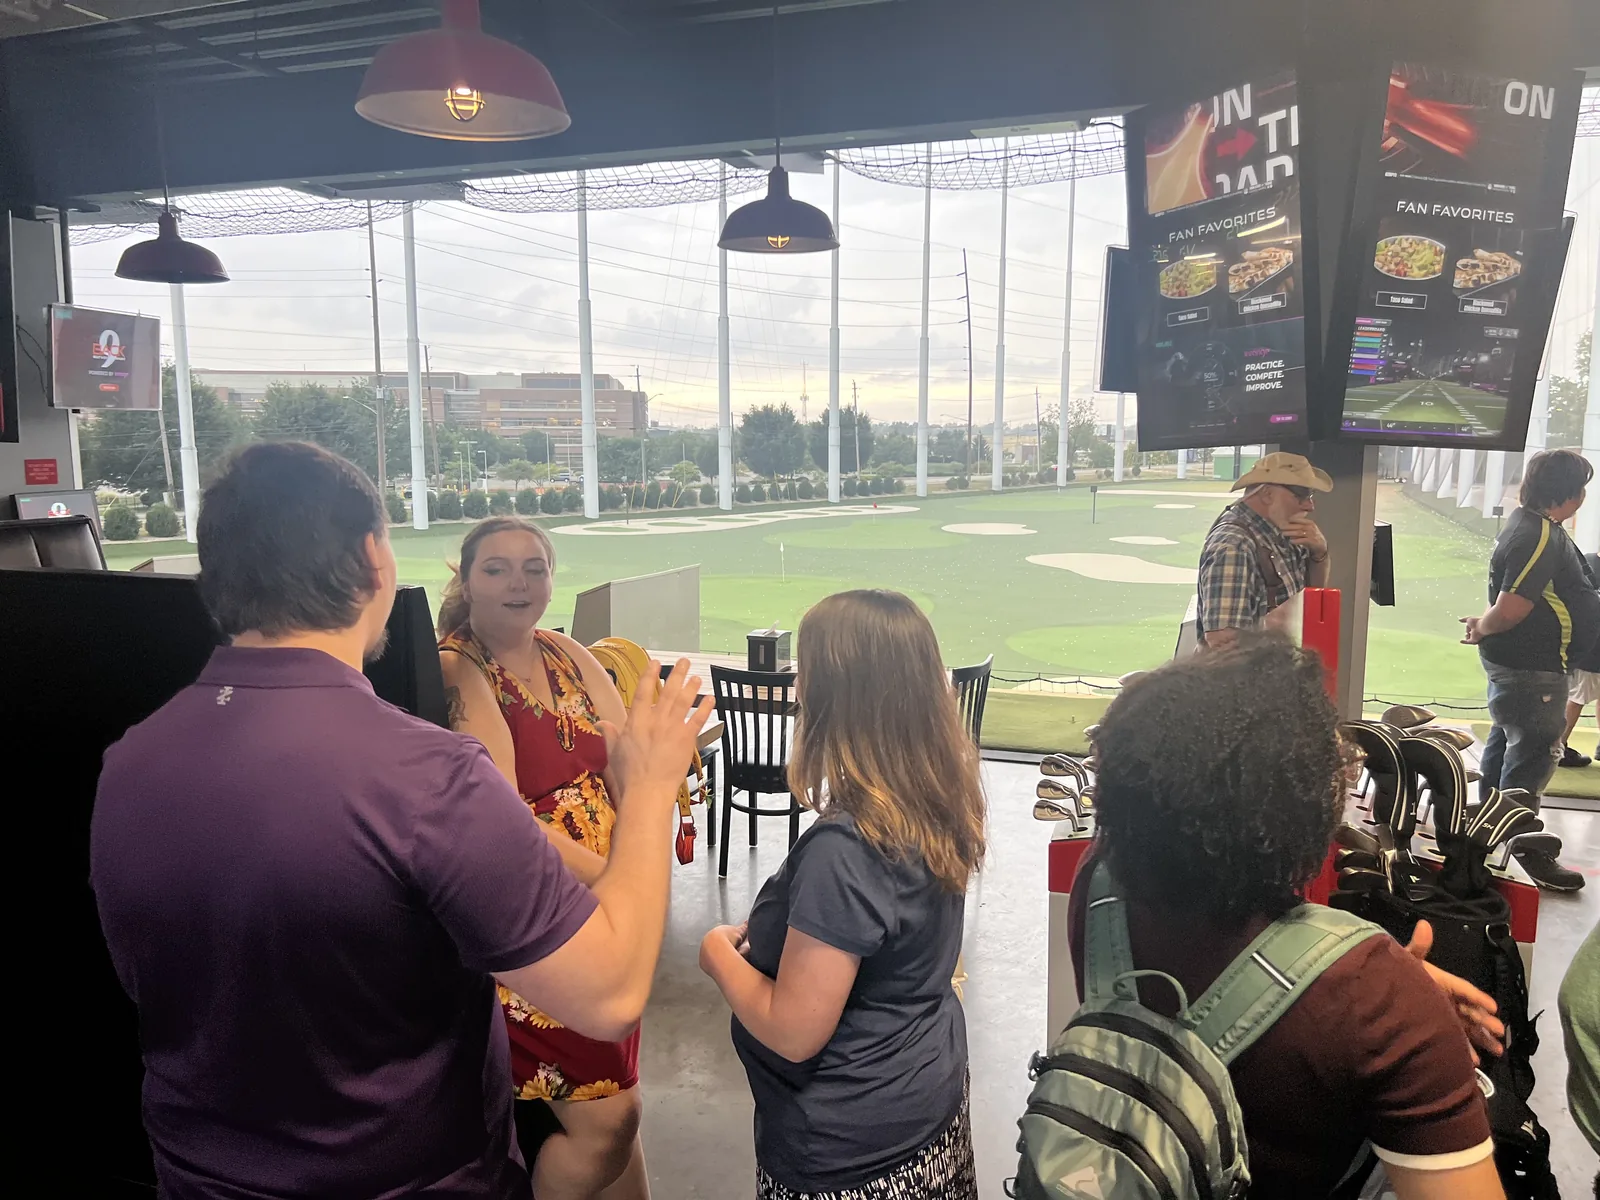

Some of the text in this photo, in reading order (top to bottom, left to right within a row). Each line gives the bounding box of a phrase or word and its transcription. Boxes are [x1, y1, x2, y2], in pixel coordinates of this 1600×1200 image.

[1504, 81, 1555, 119] ON
[1396, 201, 1515, 224] FAN FAVORITES
[1168, 206, 1276, 243] FAN FAVORITES
[1245, 360, 1285, 371] PRACTICE.
[1245, 370, 1284, 381] COMPETE.
[1245, 381, 1283, 392] IMPROVE.
